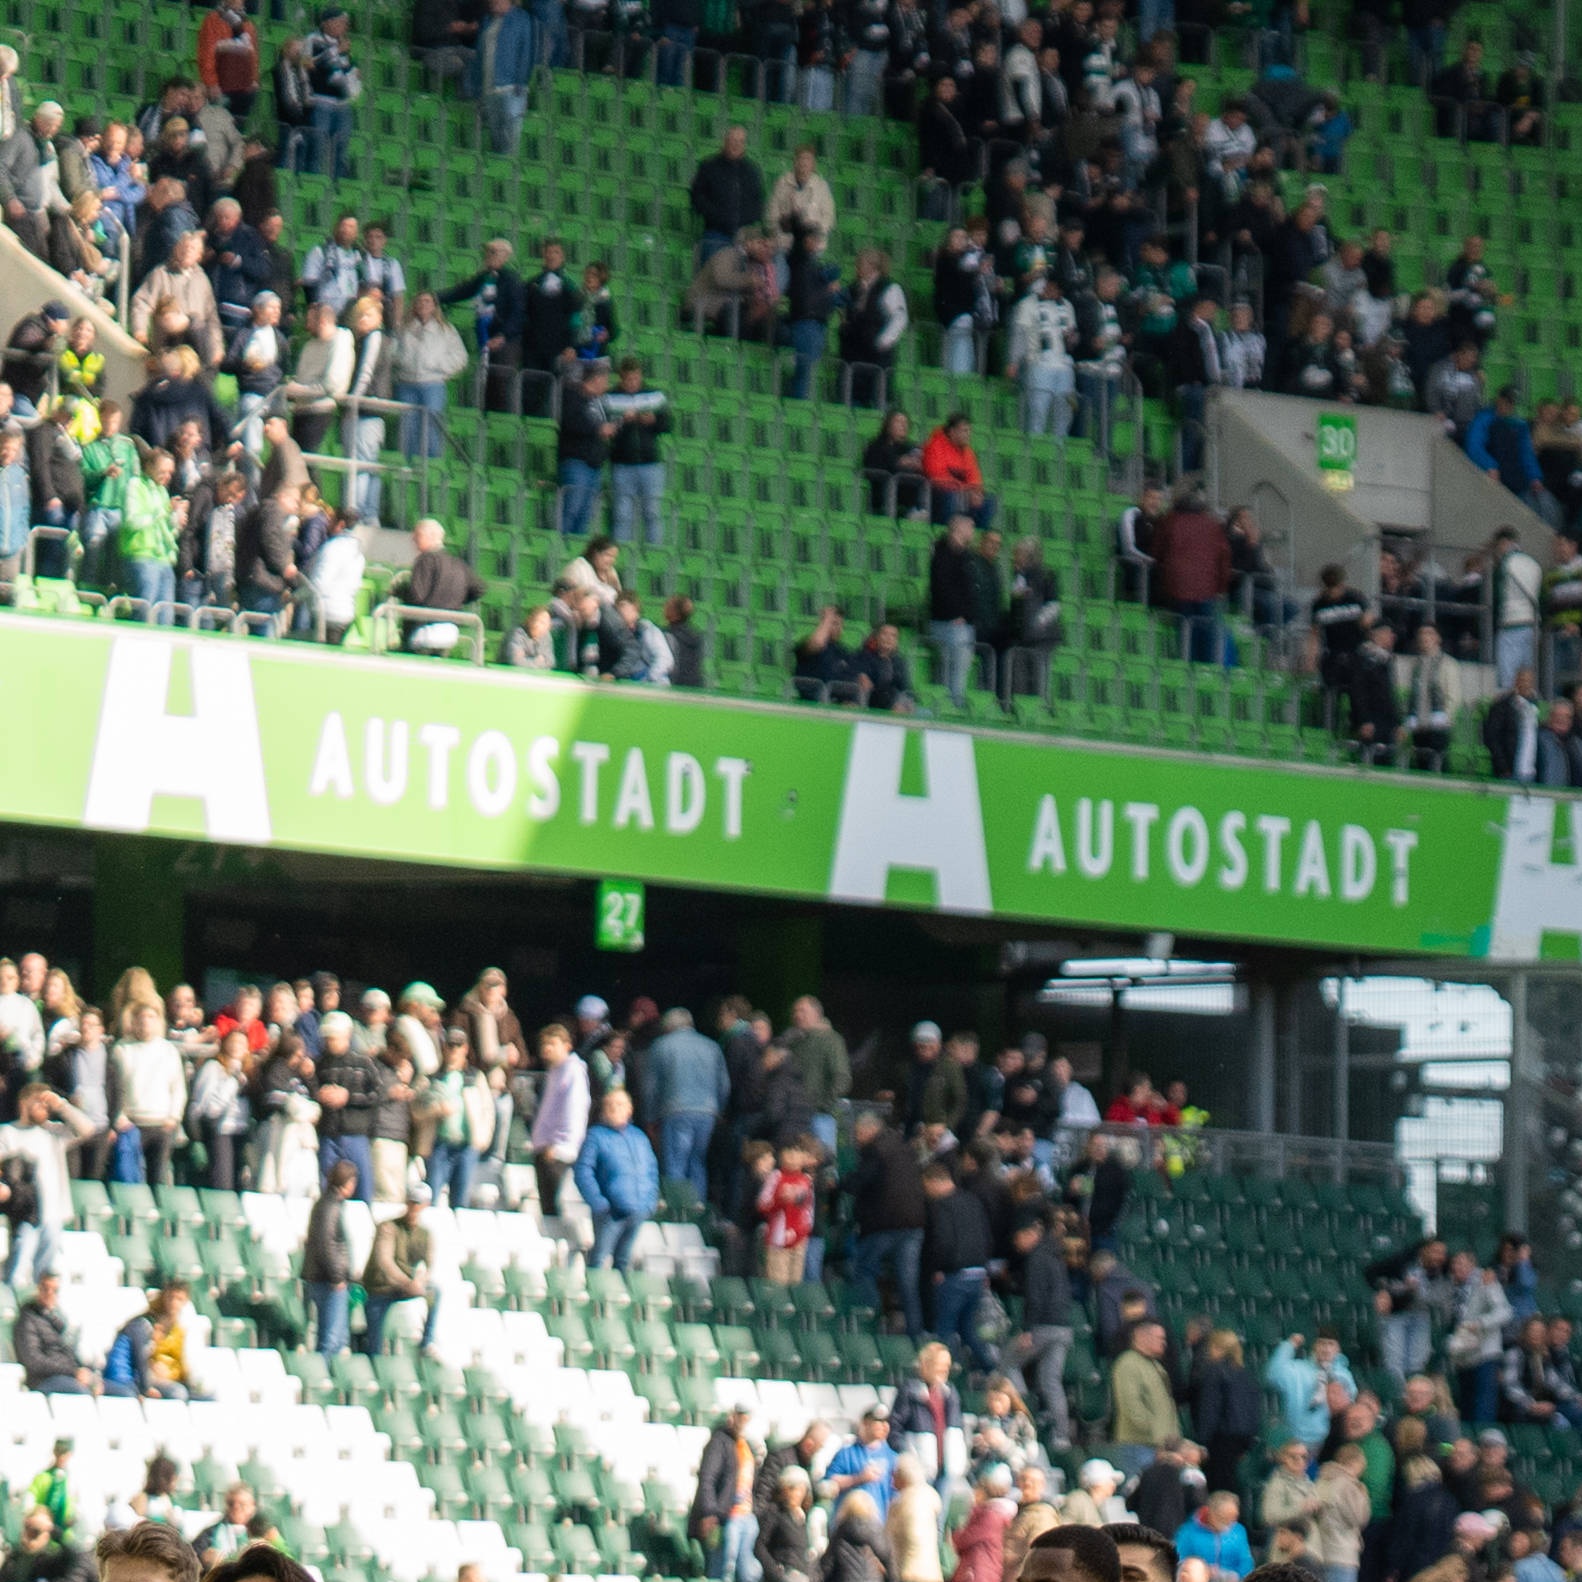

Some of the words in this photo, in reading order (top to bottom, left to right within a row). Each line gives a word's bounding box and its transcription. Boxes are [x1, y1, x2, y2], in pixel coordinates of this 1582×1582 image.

[1321, 425, 1355, 458] 30
[309, 711, 751, 840] AUTOSTADT
[1028, 793, 1418, 908] AUTOSTADT
[602, 890, 642, 928] 27
